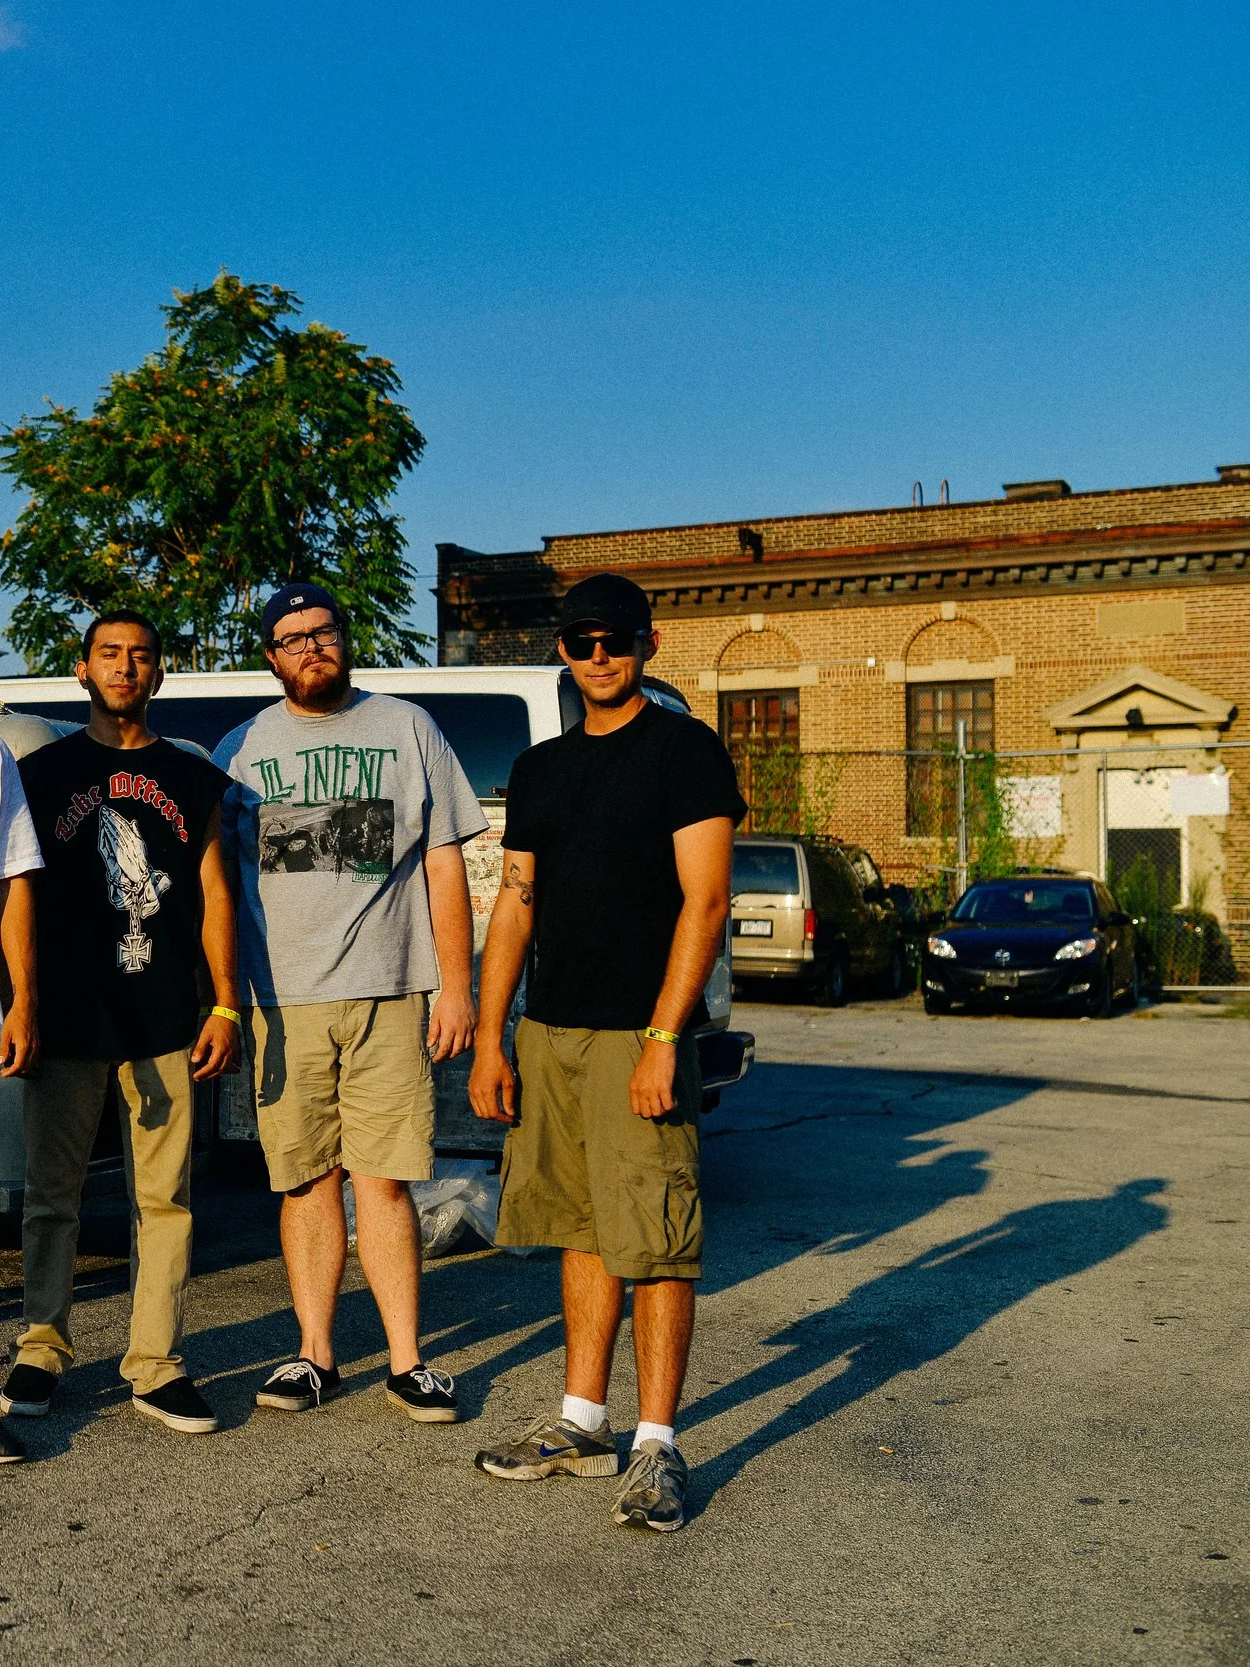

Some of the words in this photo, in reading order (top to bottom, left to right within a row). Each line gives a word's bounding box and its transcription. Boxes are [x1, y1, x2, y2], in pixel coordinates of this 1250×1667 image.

[250, 758, 296, 805] ILL
[292, 744, 397, 807] INTENT
[55, 786, 102, 841] Take
